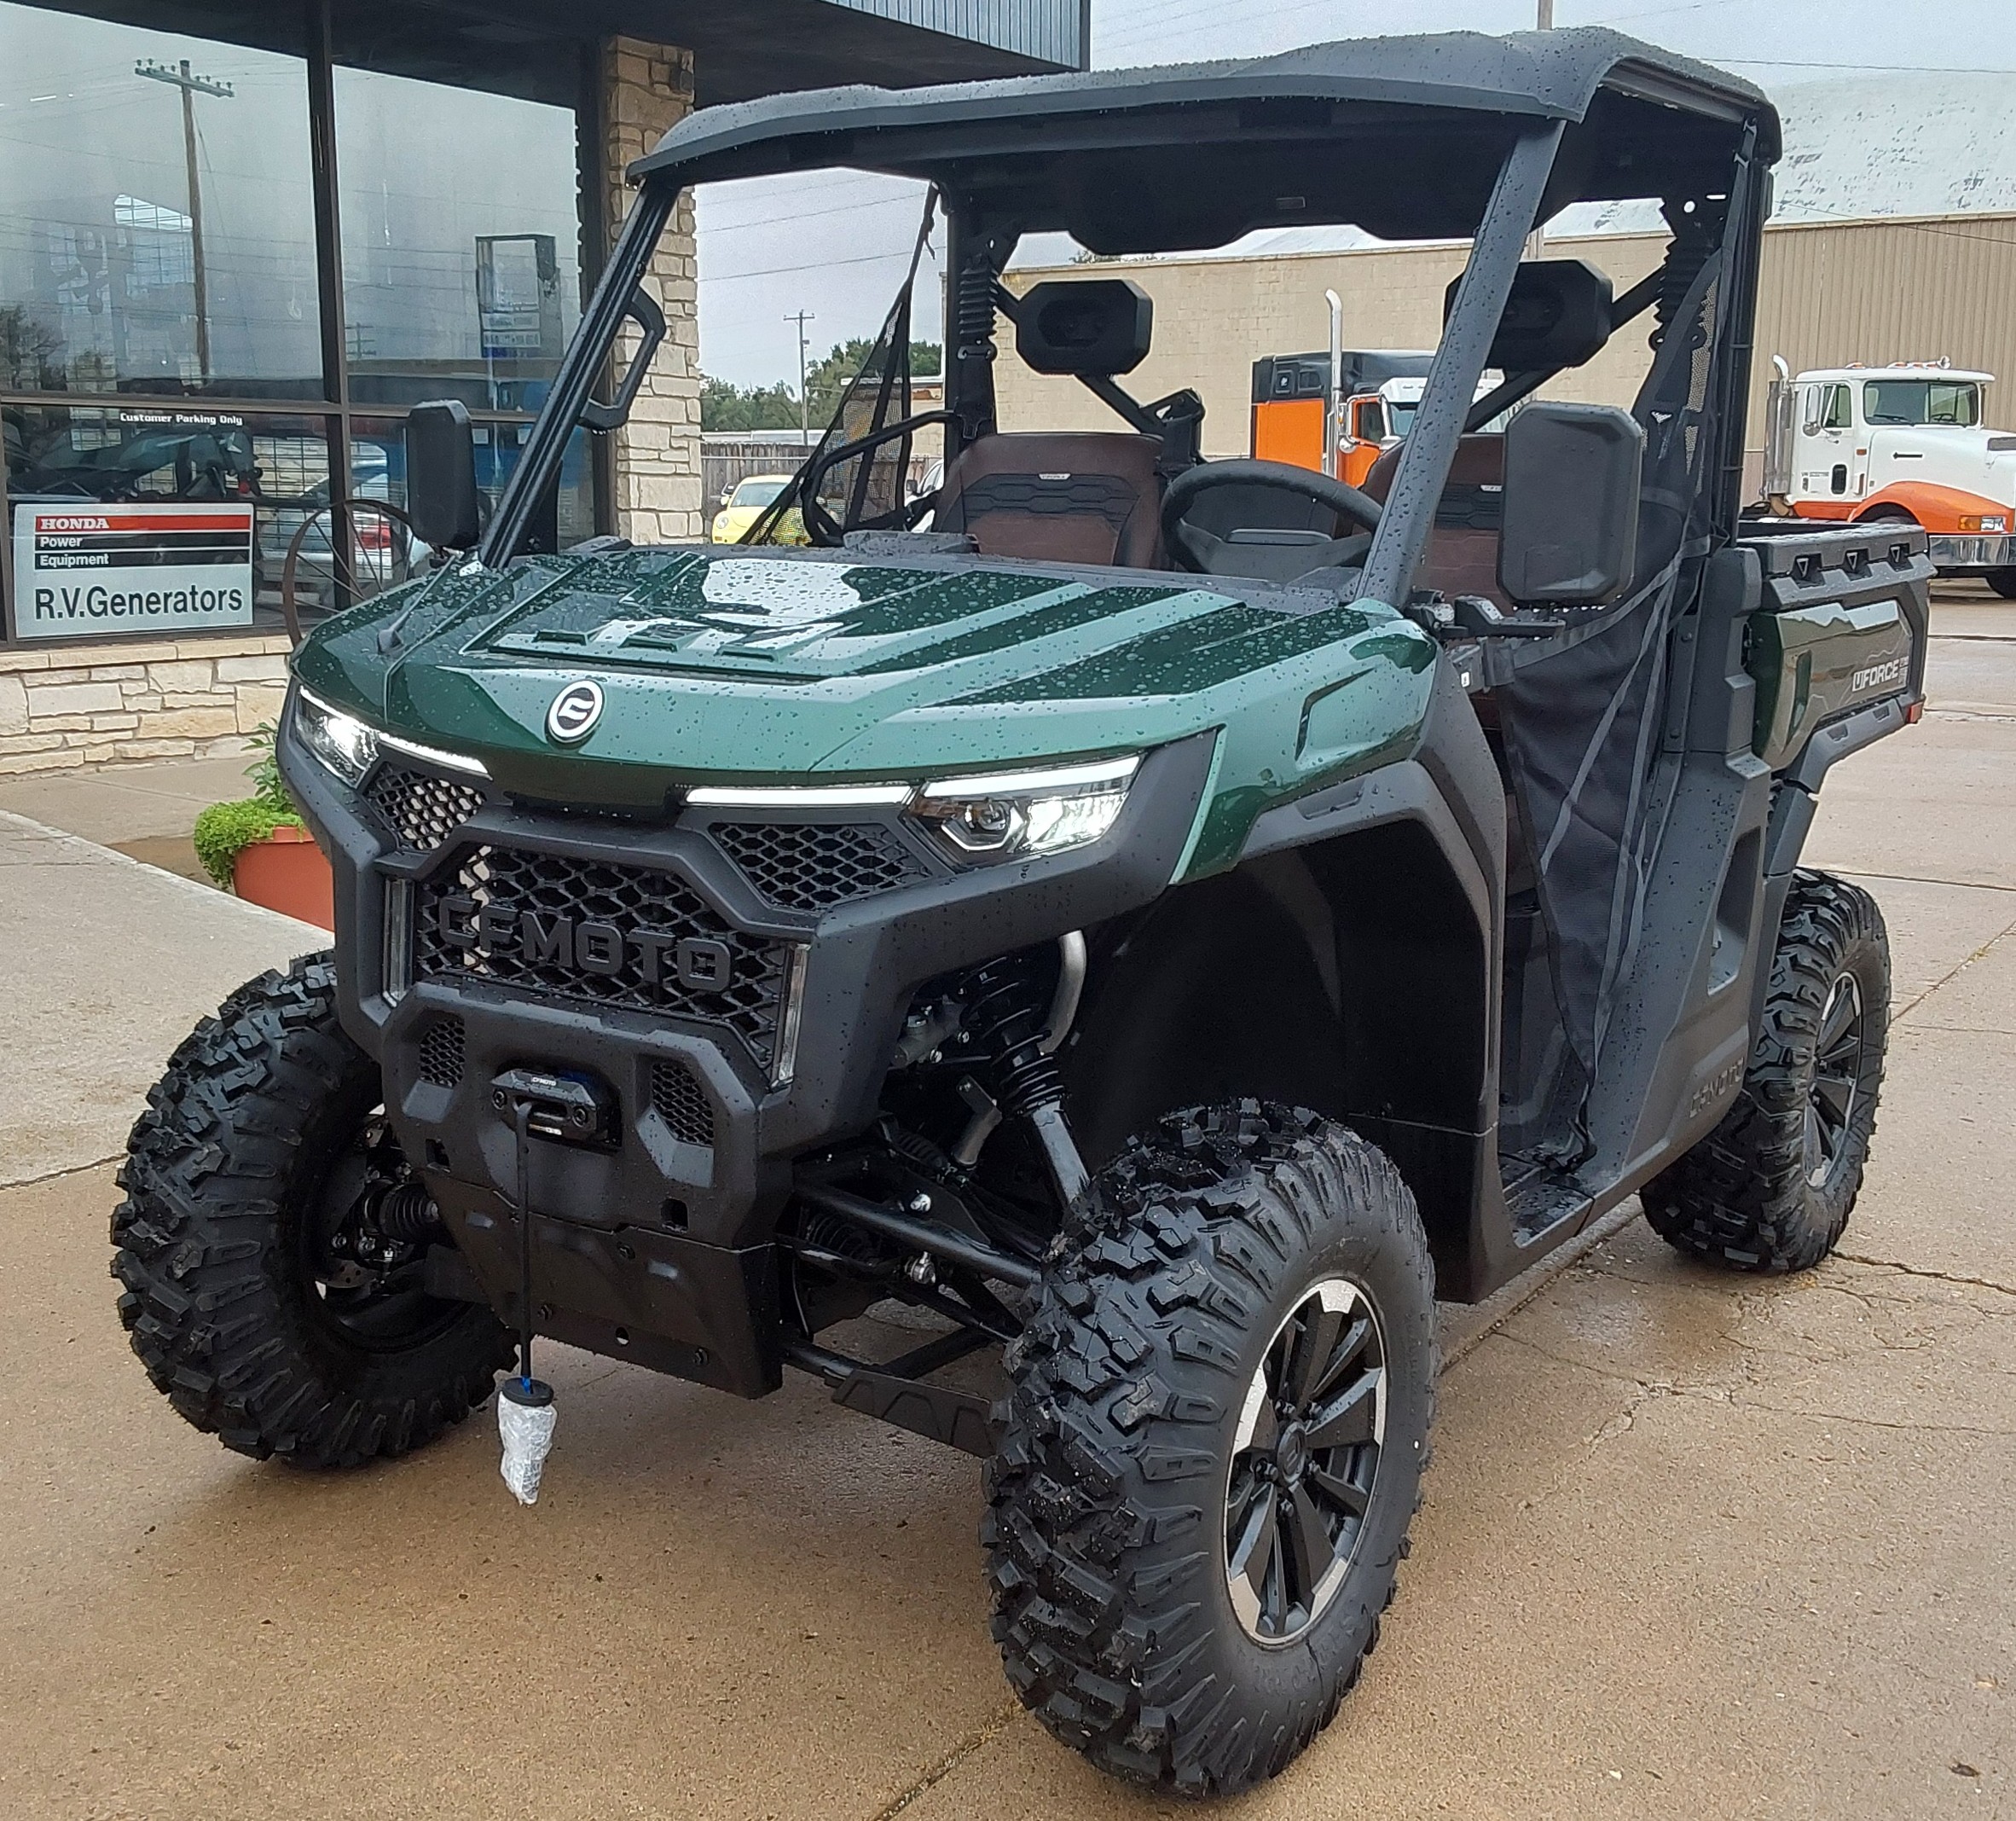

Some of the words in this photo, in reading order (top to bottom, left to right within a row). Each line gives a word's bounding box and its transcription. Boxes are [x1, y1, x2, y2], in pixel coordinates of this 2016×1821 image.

[119, 412, 172, 423] Customer
[176, 414, 217, 426] Parking
[219, 415, 243, 426] Only
[40, 518, 110, 530] HONDA
[40, 536, 83, 548] Power
[40, 554, 109, 568] Equipment
[1852, 659, 1899, 692] UFORCE
[438, 896, 732, 992] CFMOTO
